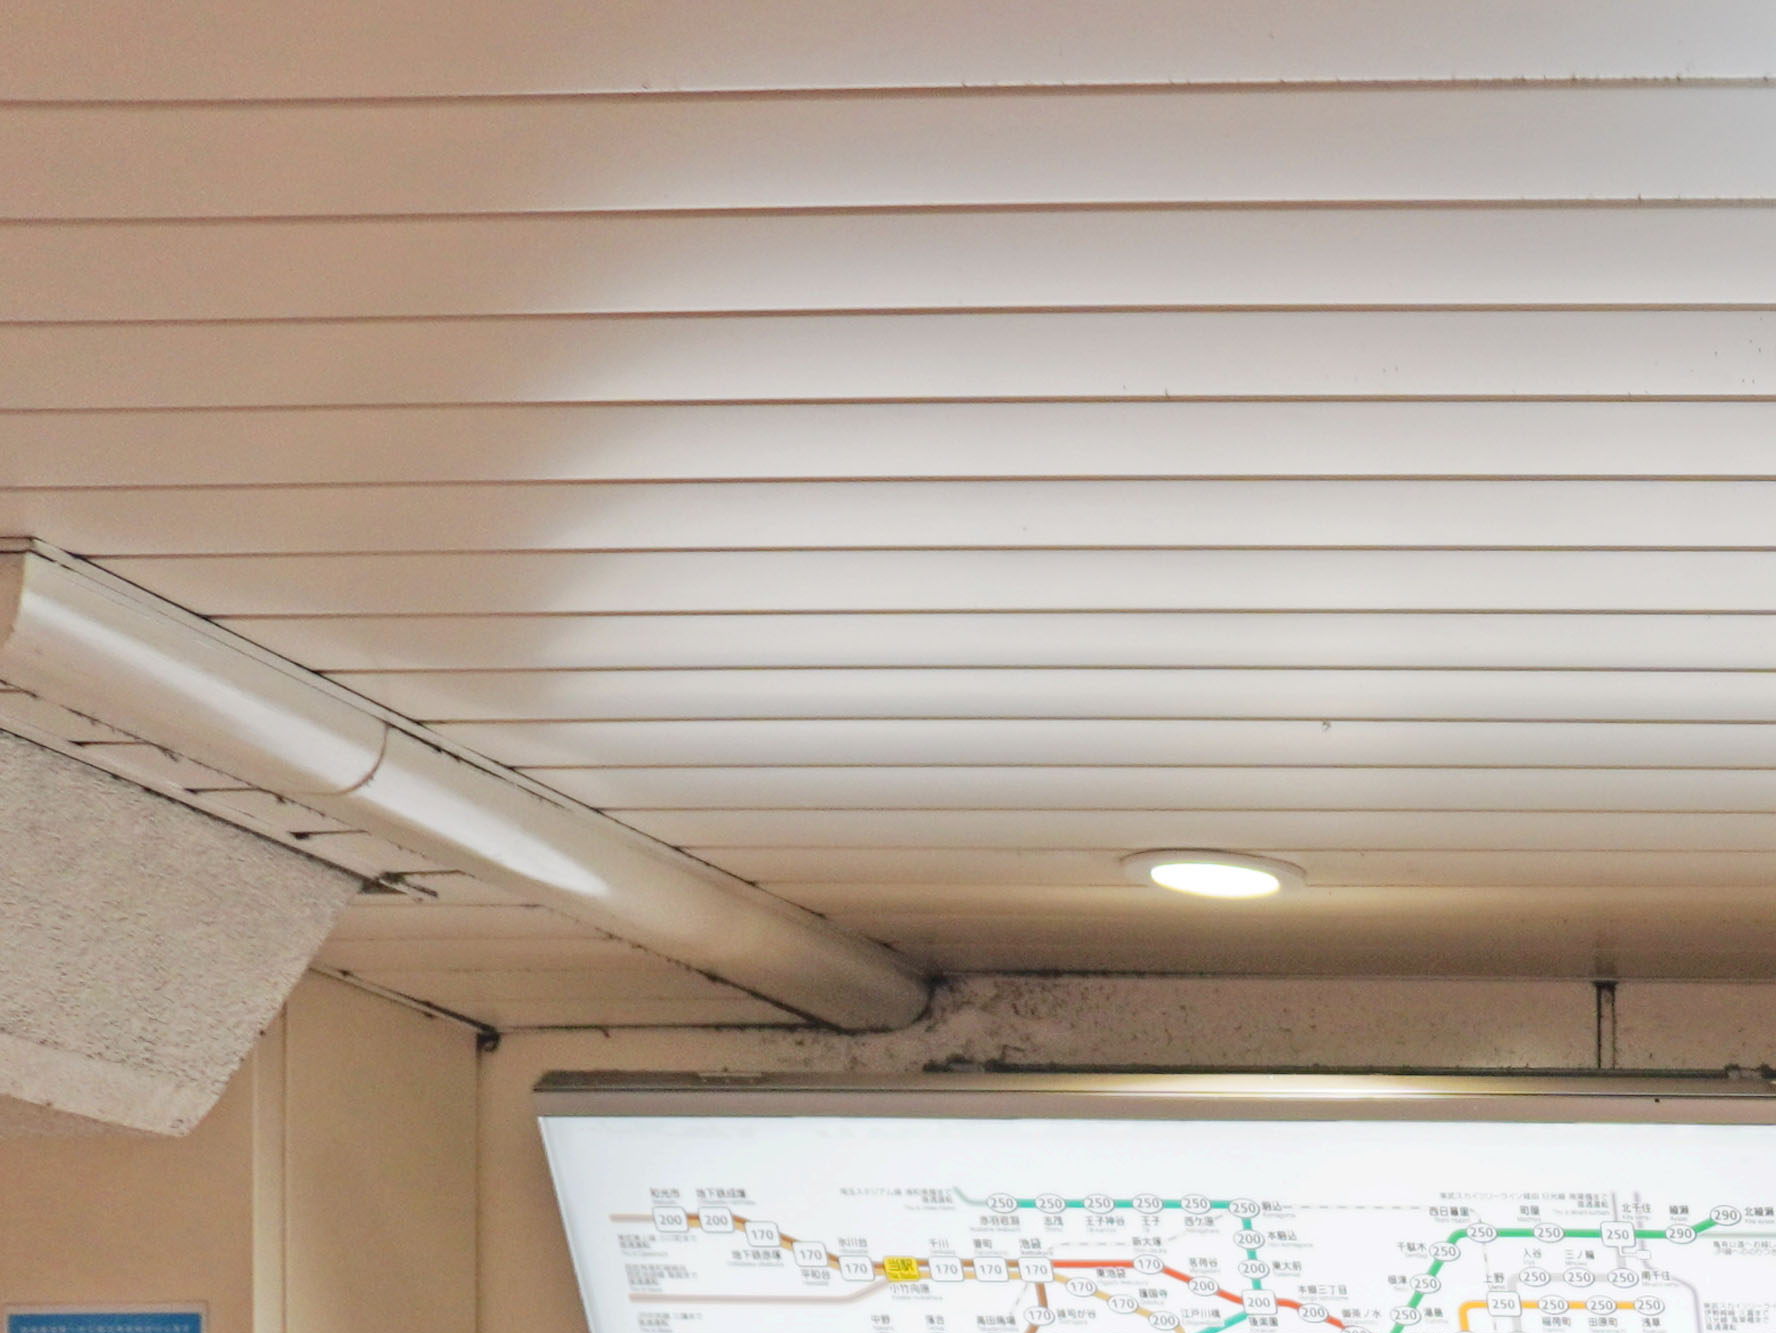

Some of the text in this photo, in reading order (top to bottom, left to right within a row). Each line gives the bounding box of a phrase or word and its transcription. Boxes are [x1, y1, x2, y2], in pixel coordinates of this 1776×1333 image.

[989, 1199, 1014, 1209] 250
[1088, 1199, 1111, 1209] 250
[1137, 1199, 1160, 1209] 250
[1714, 1210, 1737, 1220] 290
[659, 1216, 681, 1225] 200
[706, 1216, 728, 1225] 200
[751, 1230, 773, 1240] 170
[1607, 1230, 1629, 1240] 250
[1669, 1228, 1692, 1238] 290
[800, 1250, 822, 1259] 170
[846, 1264, 868, 1273] 170
[1025, 1265, 1047, 1275] 170
[1484, 1274, 1504, 1284] 上野
[1493, 1300, 1515, 1310] 250
